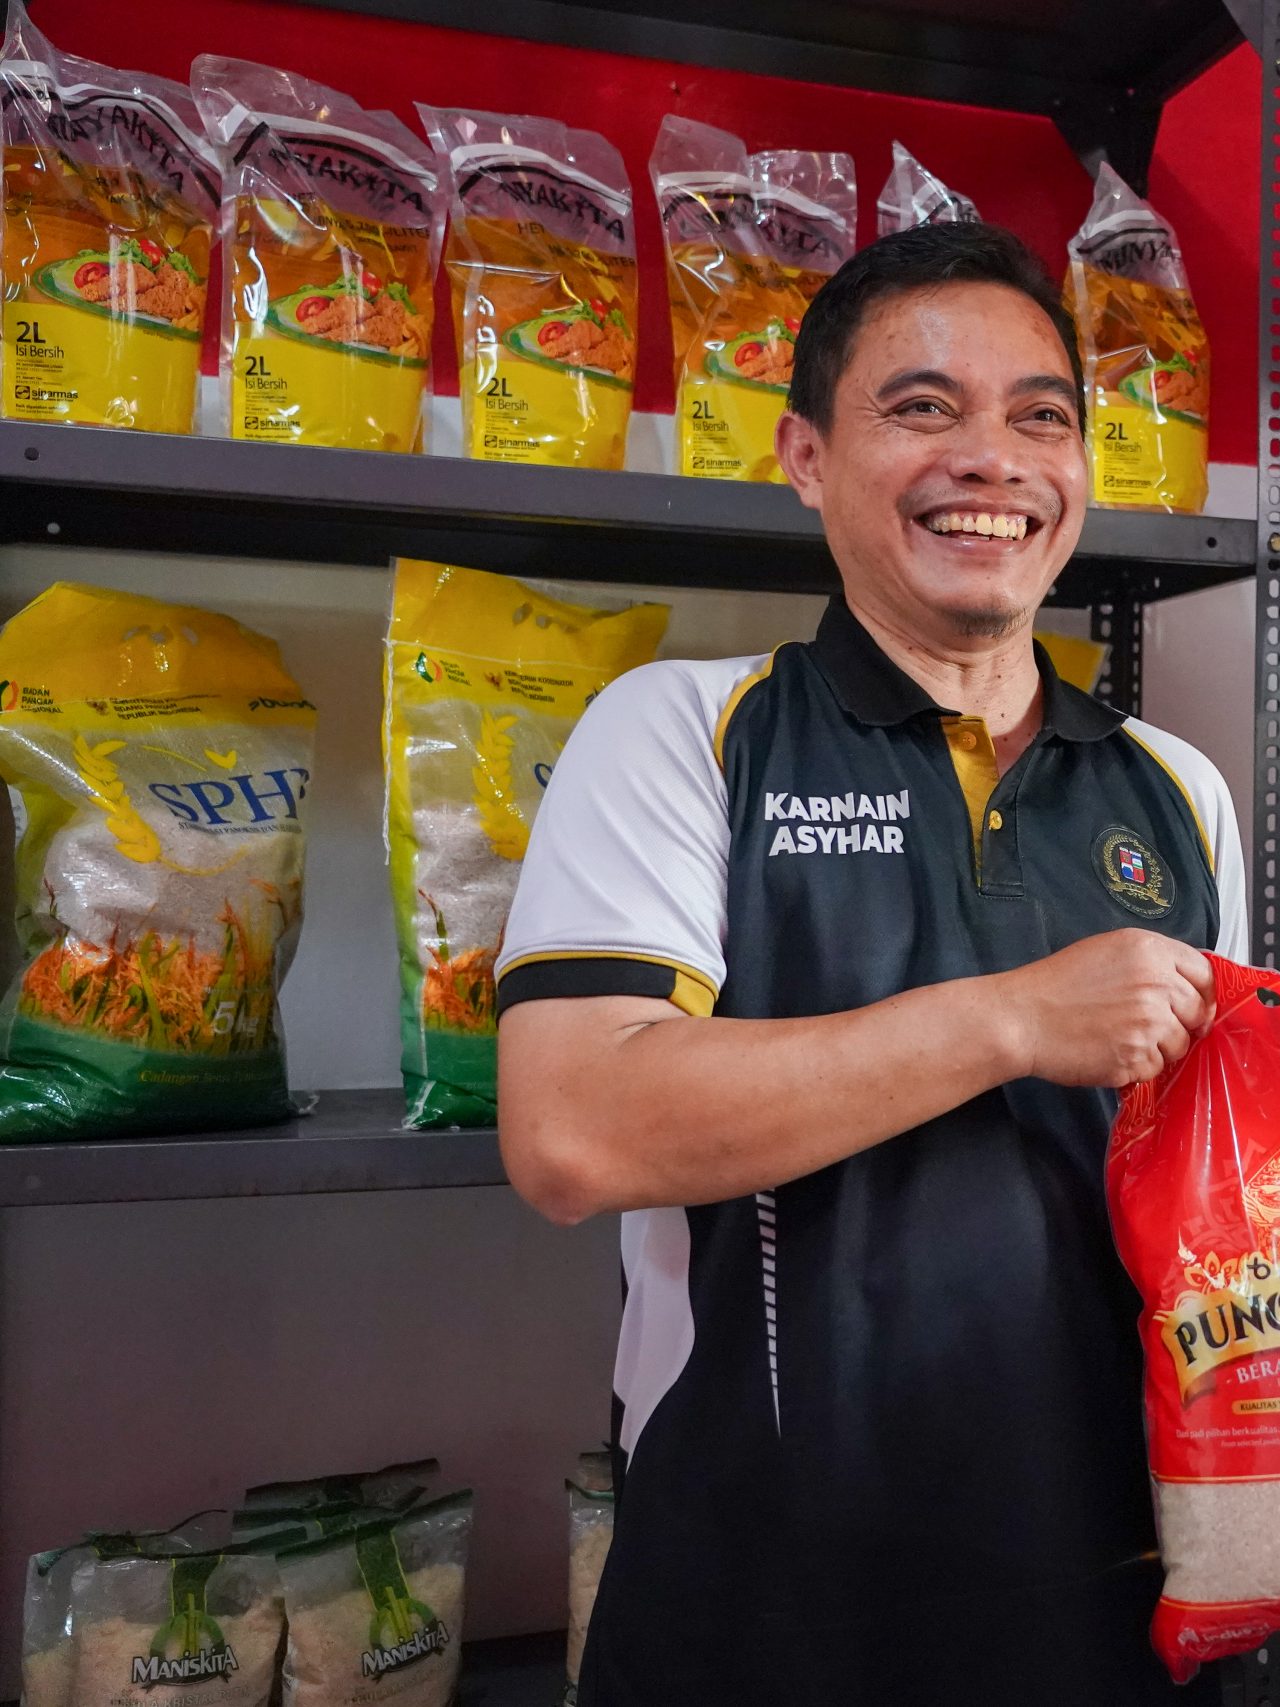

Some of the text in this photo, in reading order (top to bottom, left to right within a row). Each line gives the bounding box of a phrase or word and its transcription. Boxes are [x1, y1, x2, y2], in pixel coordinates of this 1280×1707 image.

[16, 321, 46, 343] 2L
[30, 345, 64, 359] Bersih
[245, 356, 271, 376] 2L
[258, 378, 287, 390] Bersih
[487, 378, 512, 397] 2L
[498, 399, 528, 411] Bersih
[692, 400, 715, 419] 2L
[703, 421, 729, 432] Bersih
[1105, 422, 1129, 441] 2L
[1114, 442, 1142, 453] Bersih
[764, 789, 911, 822] KARNAIN
[769, 825, 905, 857] ASYHAR
[1240, 1399, 1277, 1411] KUALITAS
